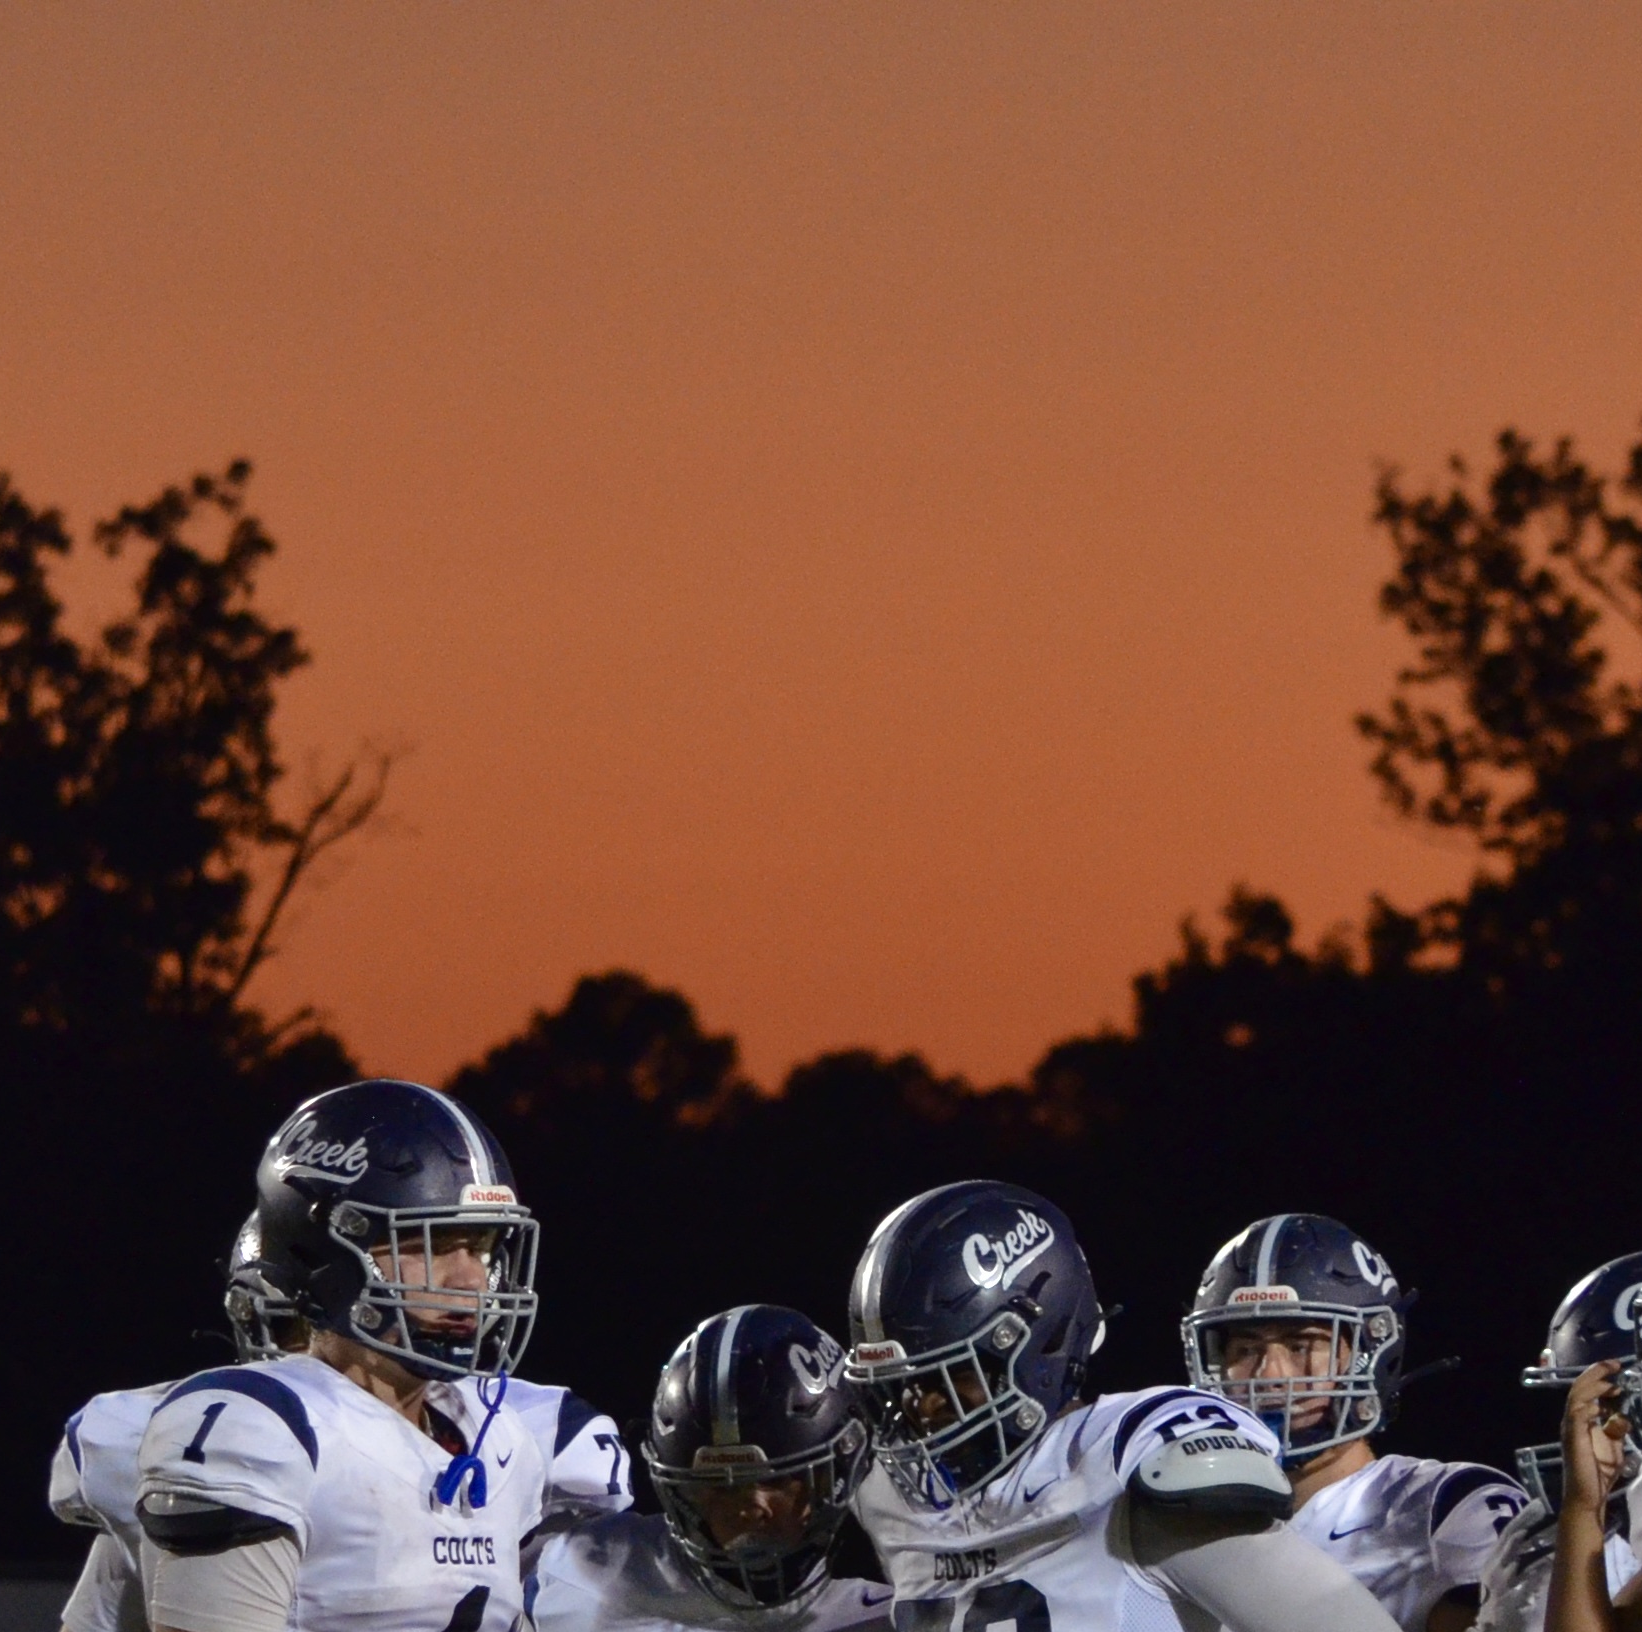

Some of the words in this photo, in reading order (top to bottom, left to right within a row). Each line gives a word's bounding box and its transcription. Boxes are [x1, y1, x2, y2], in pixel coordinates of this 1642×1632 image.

[274, 1117, 368, 1184] Creek
[962, 1209, 1055, 1291] Creek
[183, 1402, 228, 1464] 1
[592, 1433, 634, 1496] 7
[1485, 1493, 1530, 1539] 2
[433, 1537, 496, 1566] COLTS
[934, 1549, 997, 1581] COLTS
